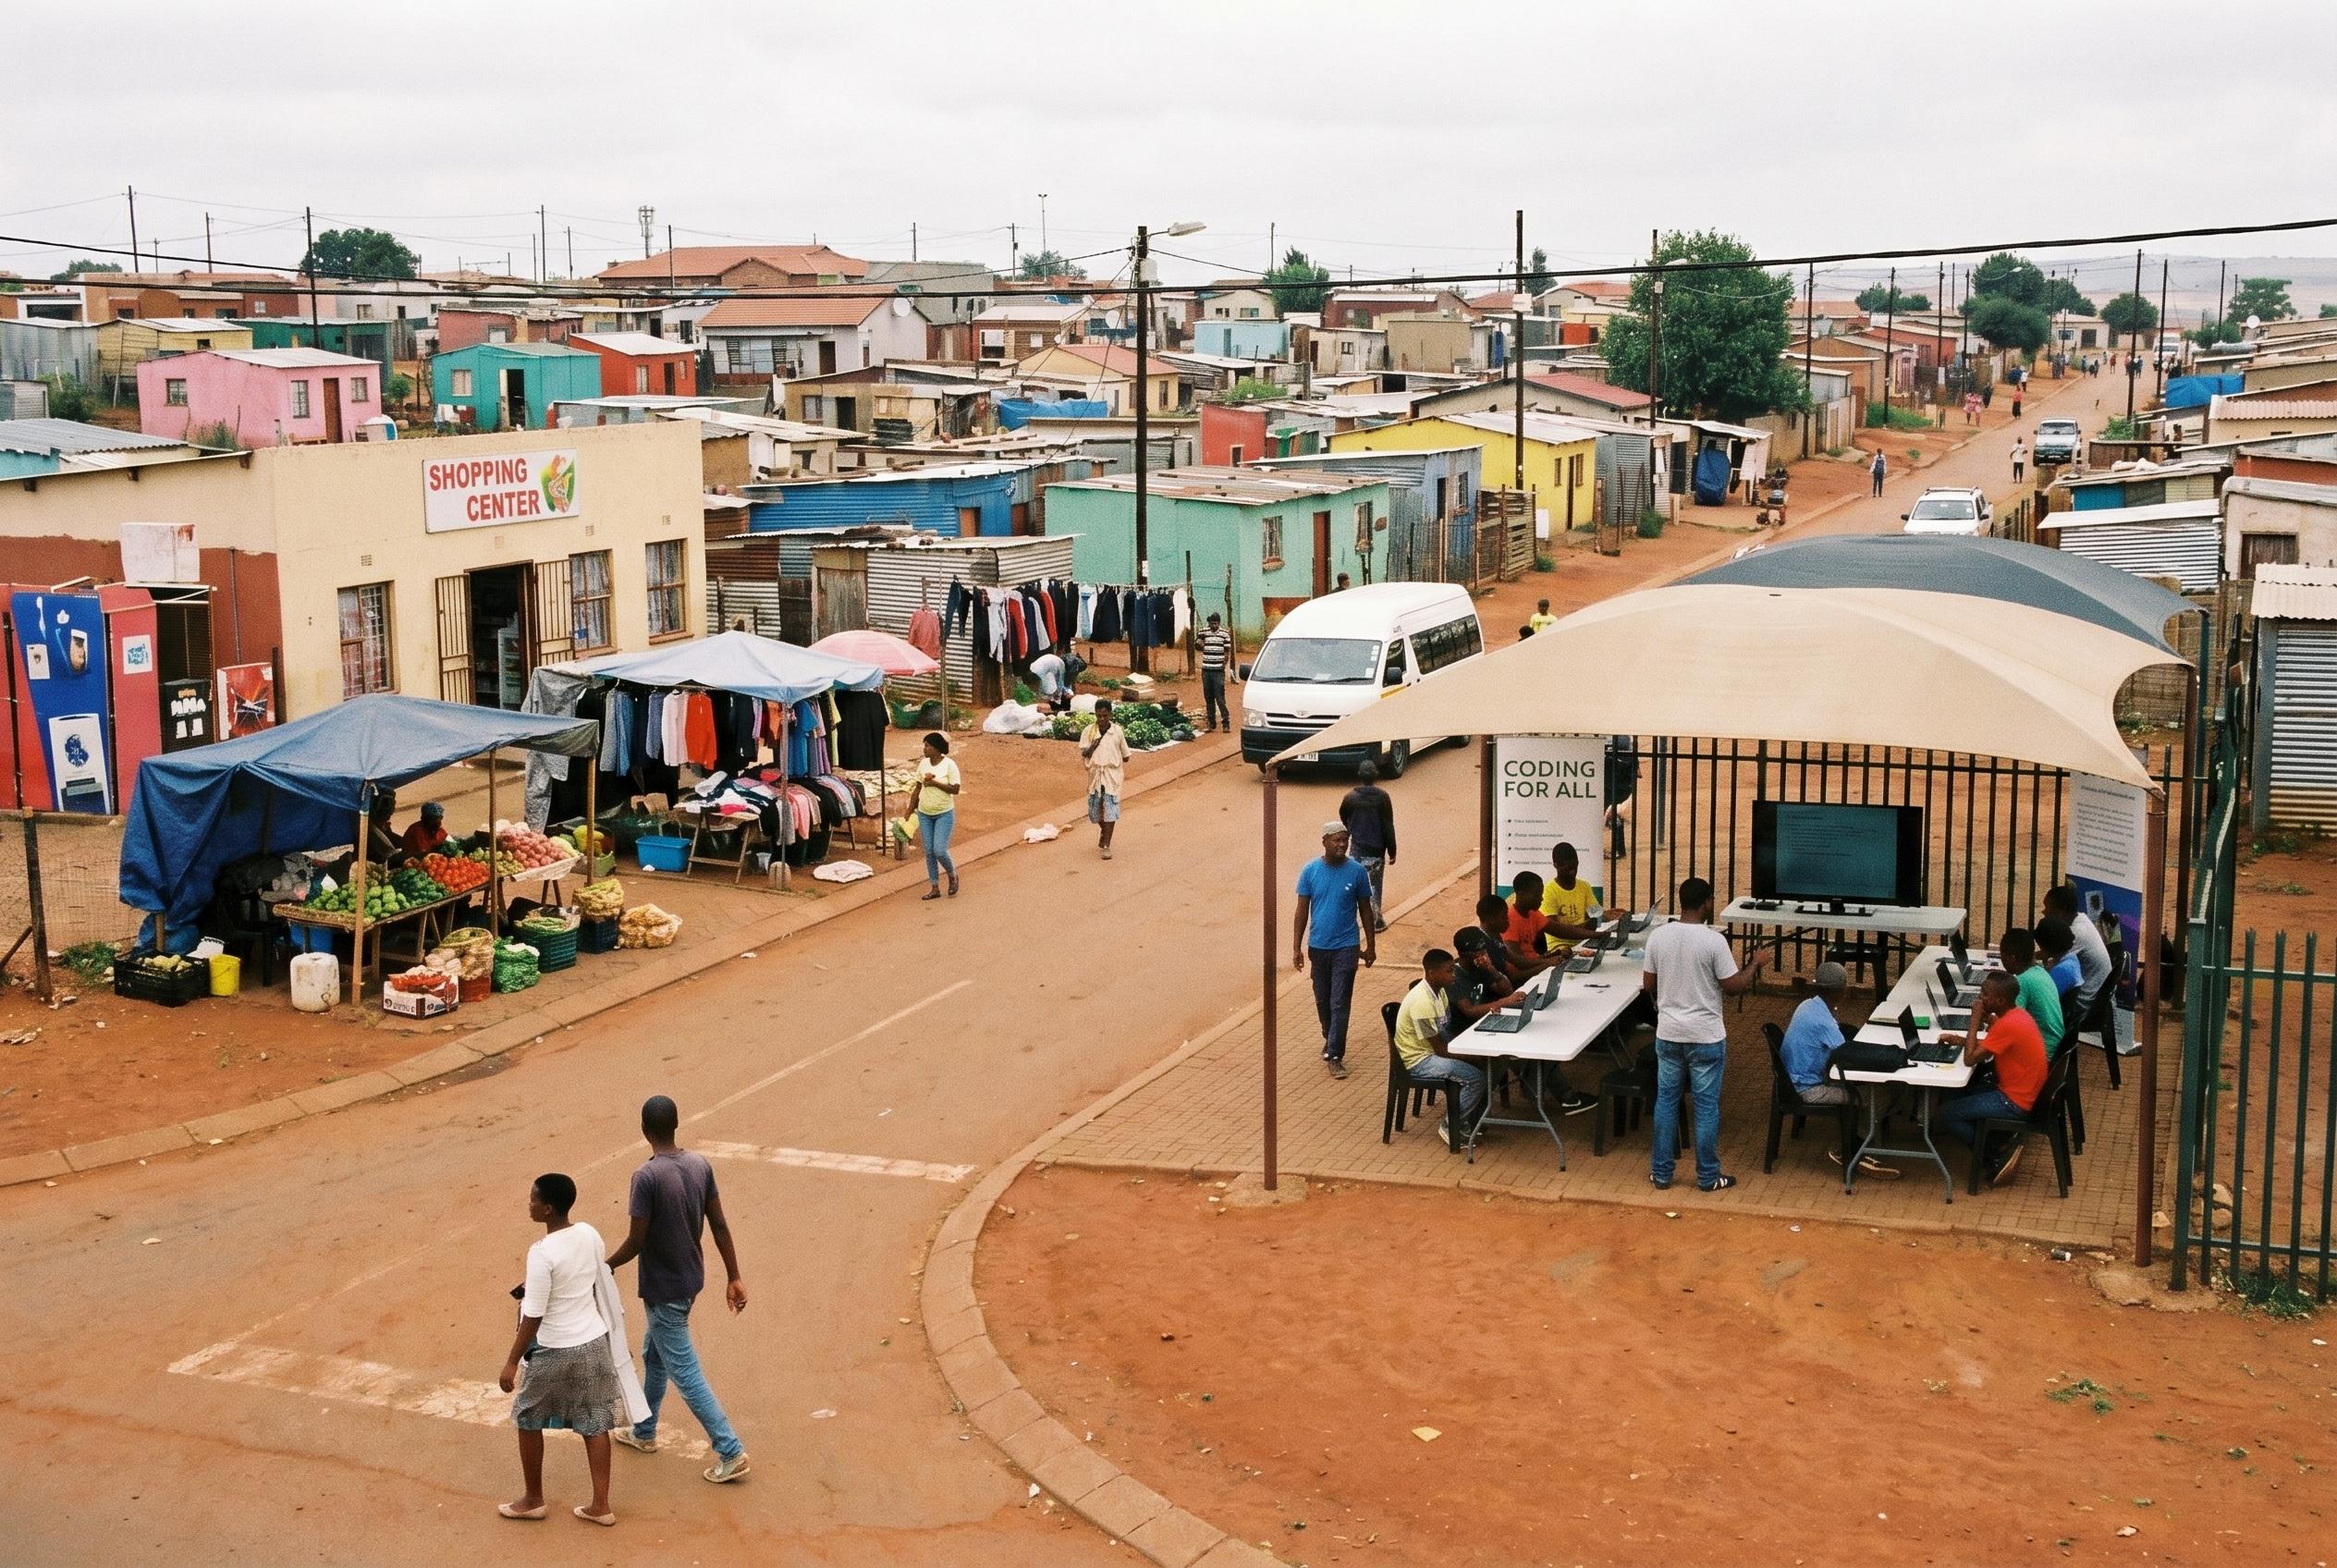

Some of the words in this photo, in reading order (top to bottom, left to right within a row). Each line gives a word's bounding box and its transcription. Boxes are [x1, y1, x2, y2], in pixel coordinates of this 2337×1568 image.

[429, 458, 528, 491] SHOPPING
[467, 489, 541, 521] CENTER
[1504, 760, 1595, 778] CODING
[1505, 781, 1548, 798] FOR
[1556, 781, 1597, 798] ALL
